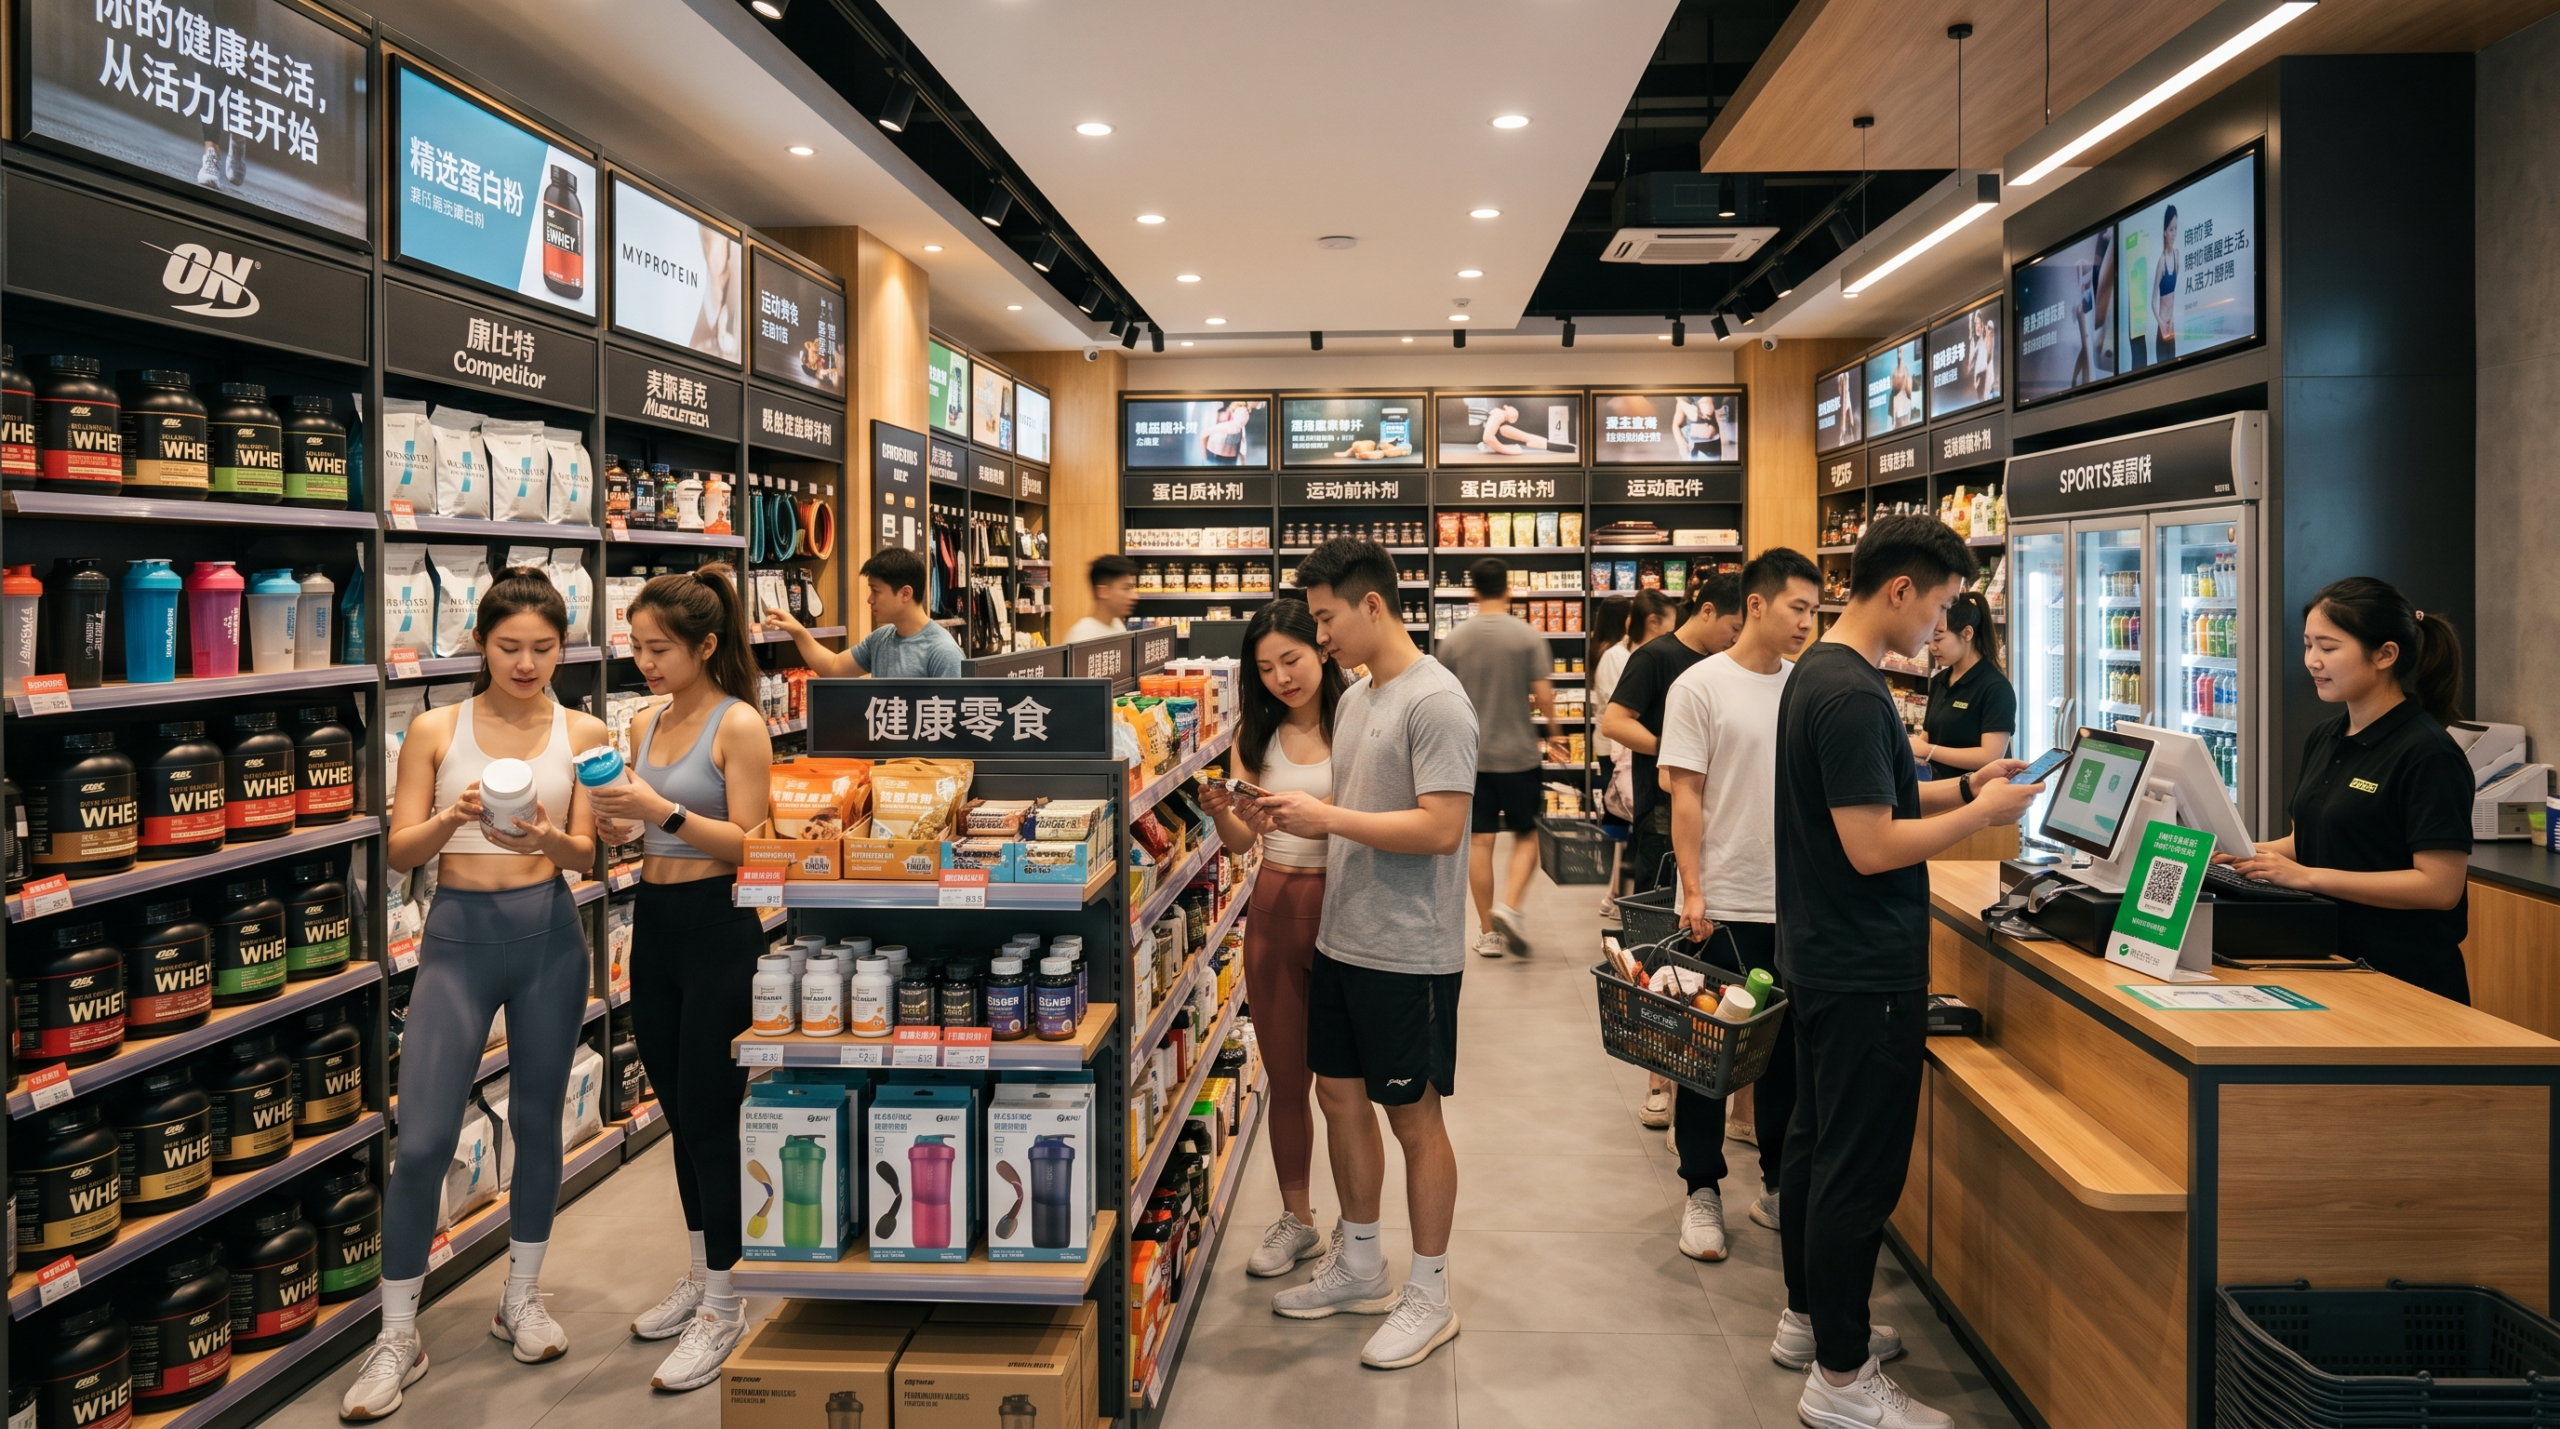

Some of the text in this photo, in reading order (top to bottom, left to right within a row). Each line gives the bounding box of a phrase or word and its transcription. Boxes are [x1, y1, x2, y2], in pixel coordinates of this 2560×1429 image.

[98, 36, 319, 165] 从活力佳开始
[410, 135, 525, 217] 精选蛋白粉
[162, 243, 255, 305] ON
[622, 242, 698, 289] MYPROTEIN
[466, 317, 535, 363] 康比特
[453, 350, 547, 390] Competitor
[1152, 482, 1244, 501] 蛋白质补剂
[1306, 481, 1399, 500] 运动前补剂
[1460, 479, 1555, 498] 蛋白质补剂
[1627, 479, 1704, 498] 运动配件
[864, 695, 1052, 743] 健康零食
